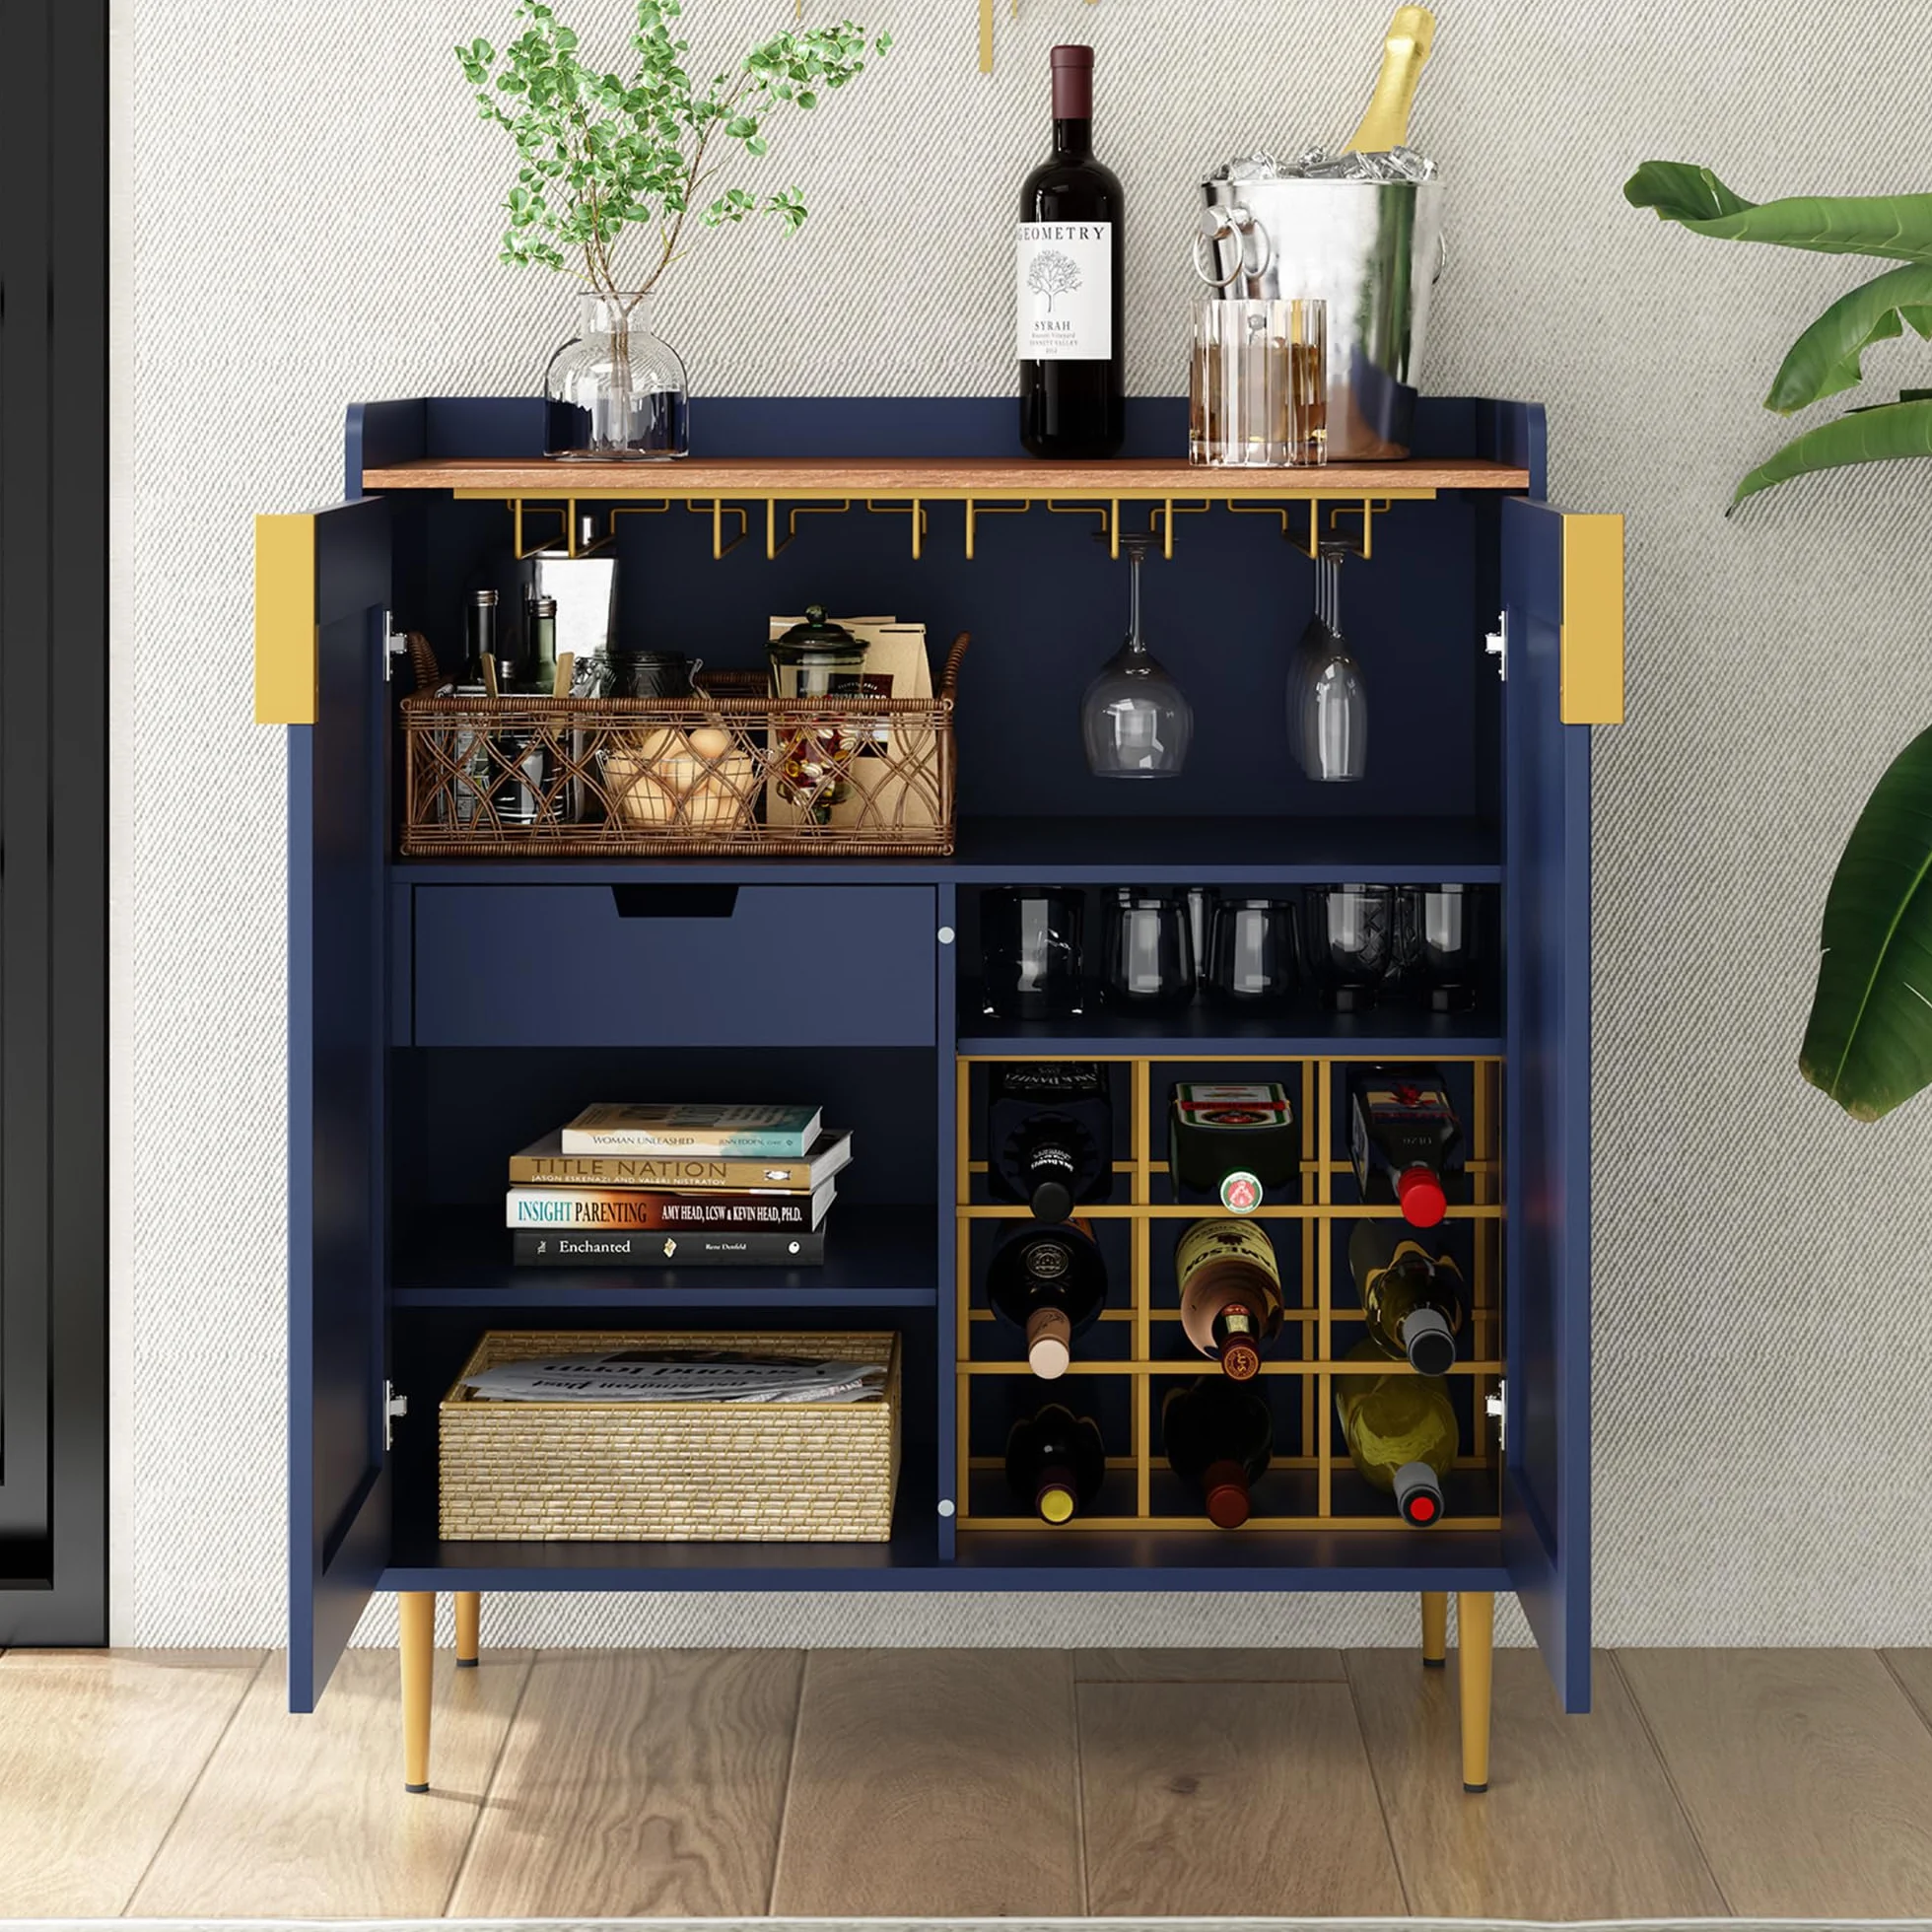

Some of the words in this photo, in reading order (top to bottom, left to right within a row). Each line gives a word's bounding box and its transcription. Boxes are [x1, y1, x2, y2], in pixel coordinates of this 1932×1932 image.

[1034, 320, 1070, 331] SYRAH
[592, 1136, 634, 1144] WOMAN
[637, 1137, 694, 1145] UNLEASHED
[531, 1158, 604, 1175] TITLE
[617, 1160, 726, 1177] NATION
[518, 1201, 572, 1221] INSIGHT
[575, 1202, 647, 1223] PARENTING
[661, 1206, 680, 1220] AMY
[681, 1206, 705, 1223] HEAD,
[706, 1206, 726, 1221] LCSW
[733, 1207, 757, 1221] KEVIN
[757, 1207, 781, 1224] HEAD,
[782, 1207, 802, 1221] PH.D.
[559, 1240, 631, 1253] Enchanted
